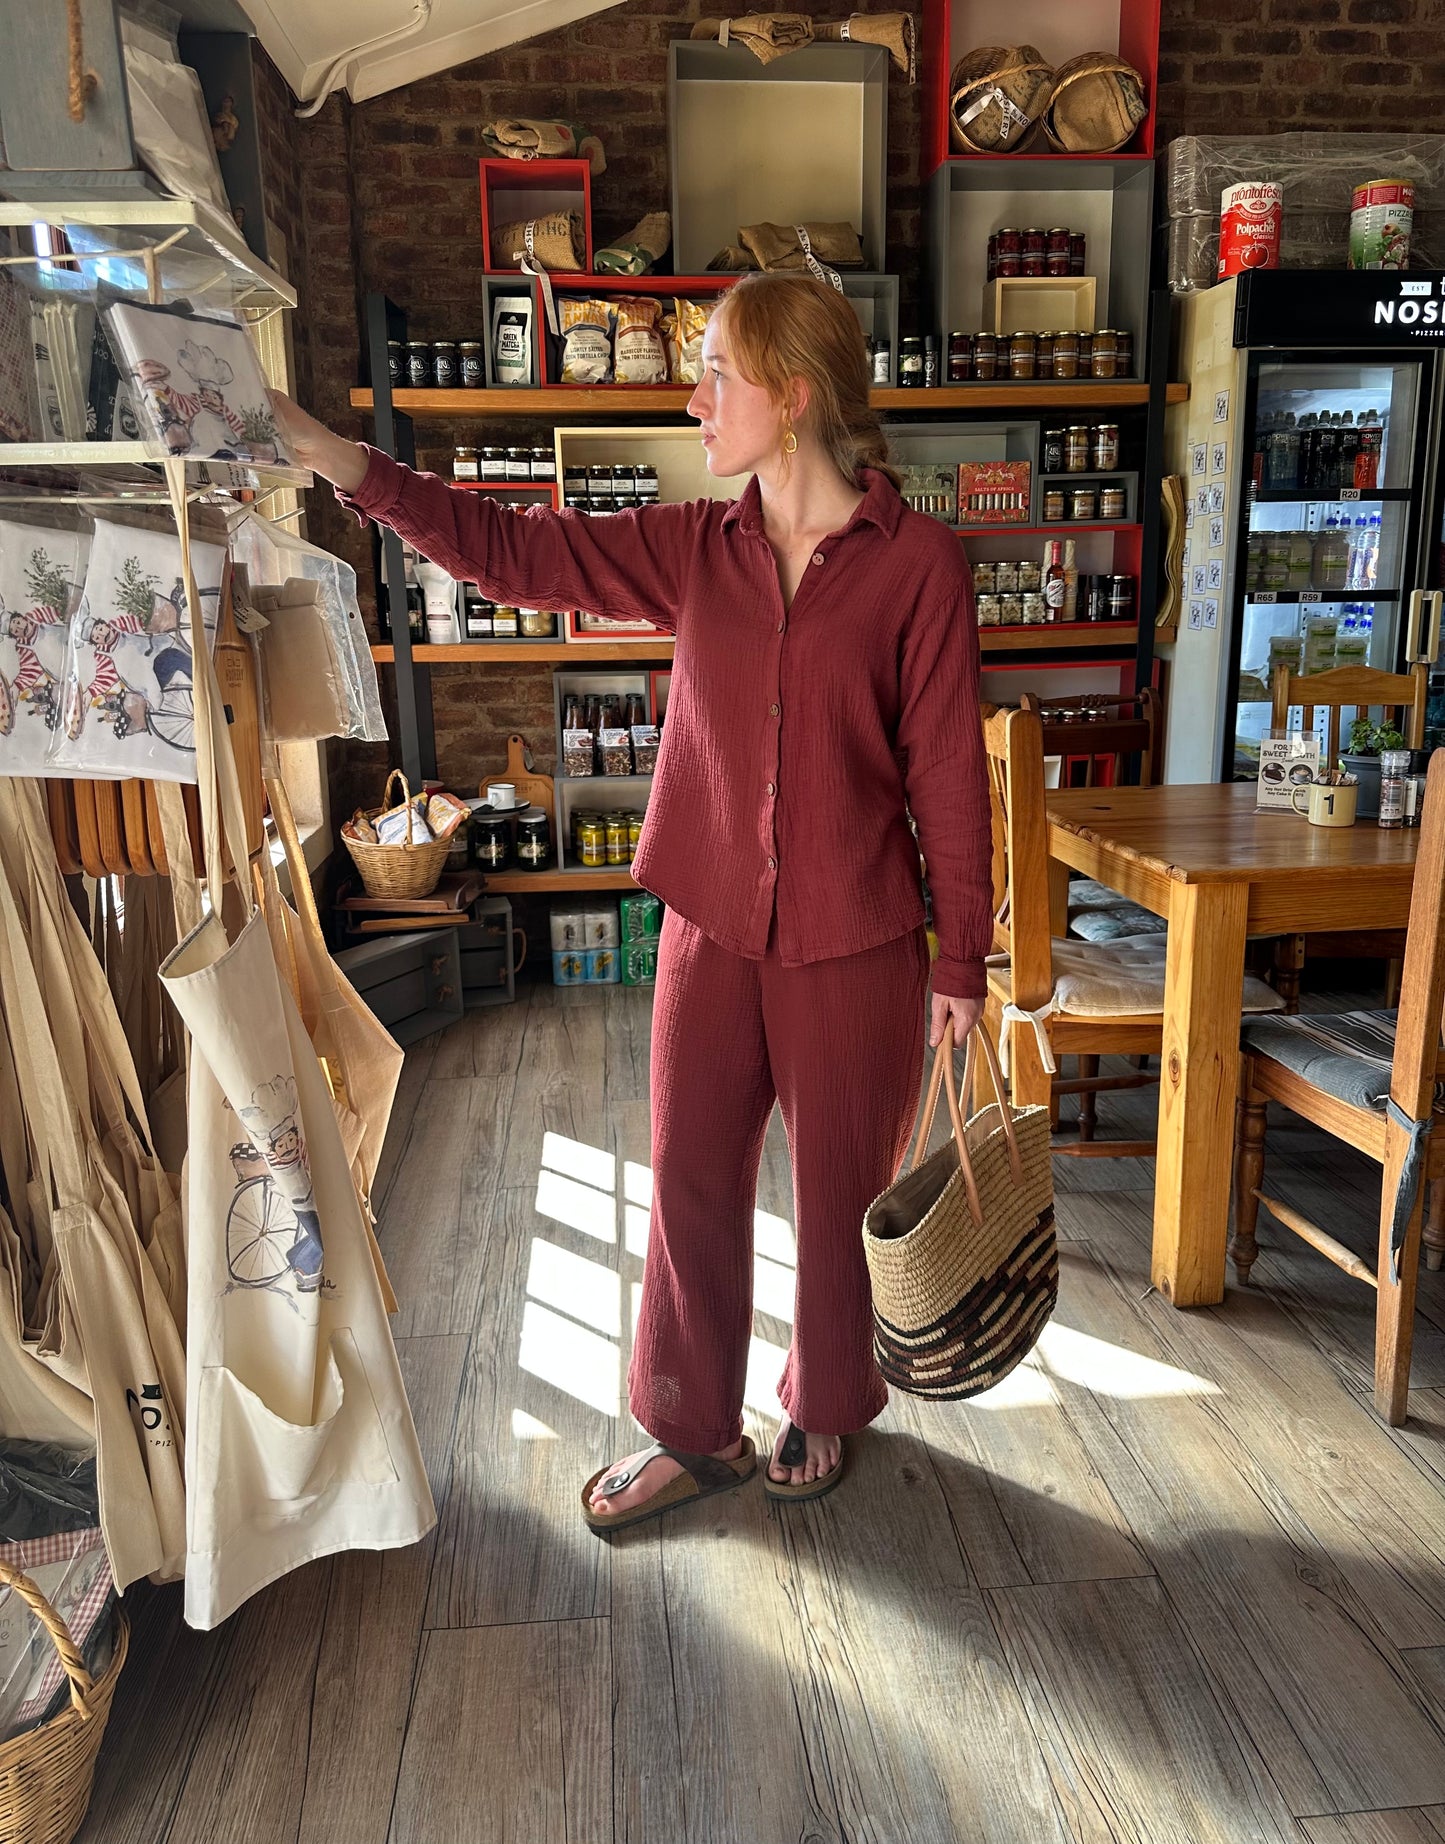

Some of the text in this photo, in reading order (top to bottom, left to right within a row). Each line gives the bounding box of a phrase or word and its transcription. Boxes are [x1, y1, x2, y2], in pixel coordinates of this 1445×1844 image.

[503, 332, 518, 341] GREEN
[1341, 490, 1358, 499] R20
[1257, 593, 1274, 602] R65
[1301, 593, 1319, 602] R59
[1324, 794, 1335, 815] 1
